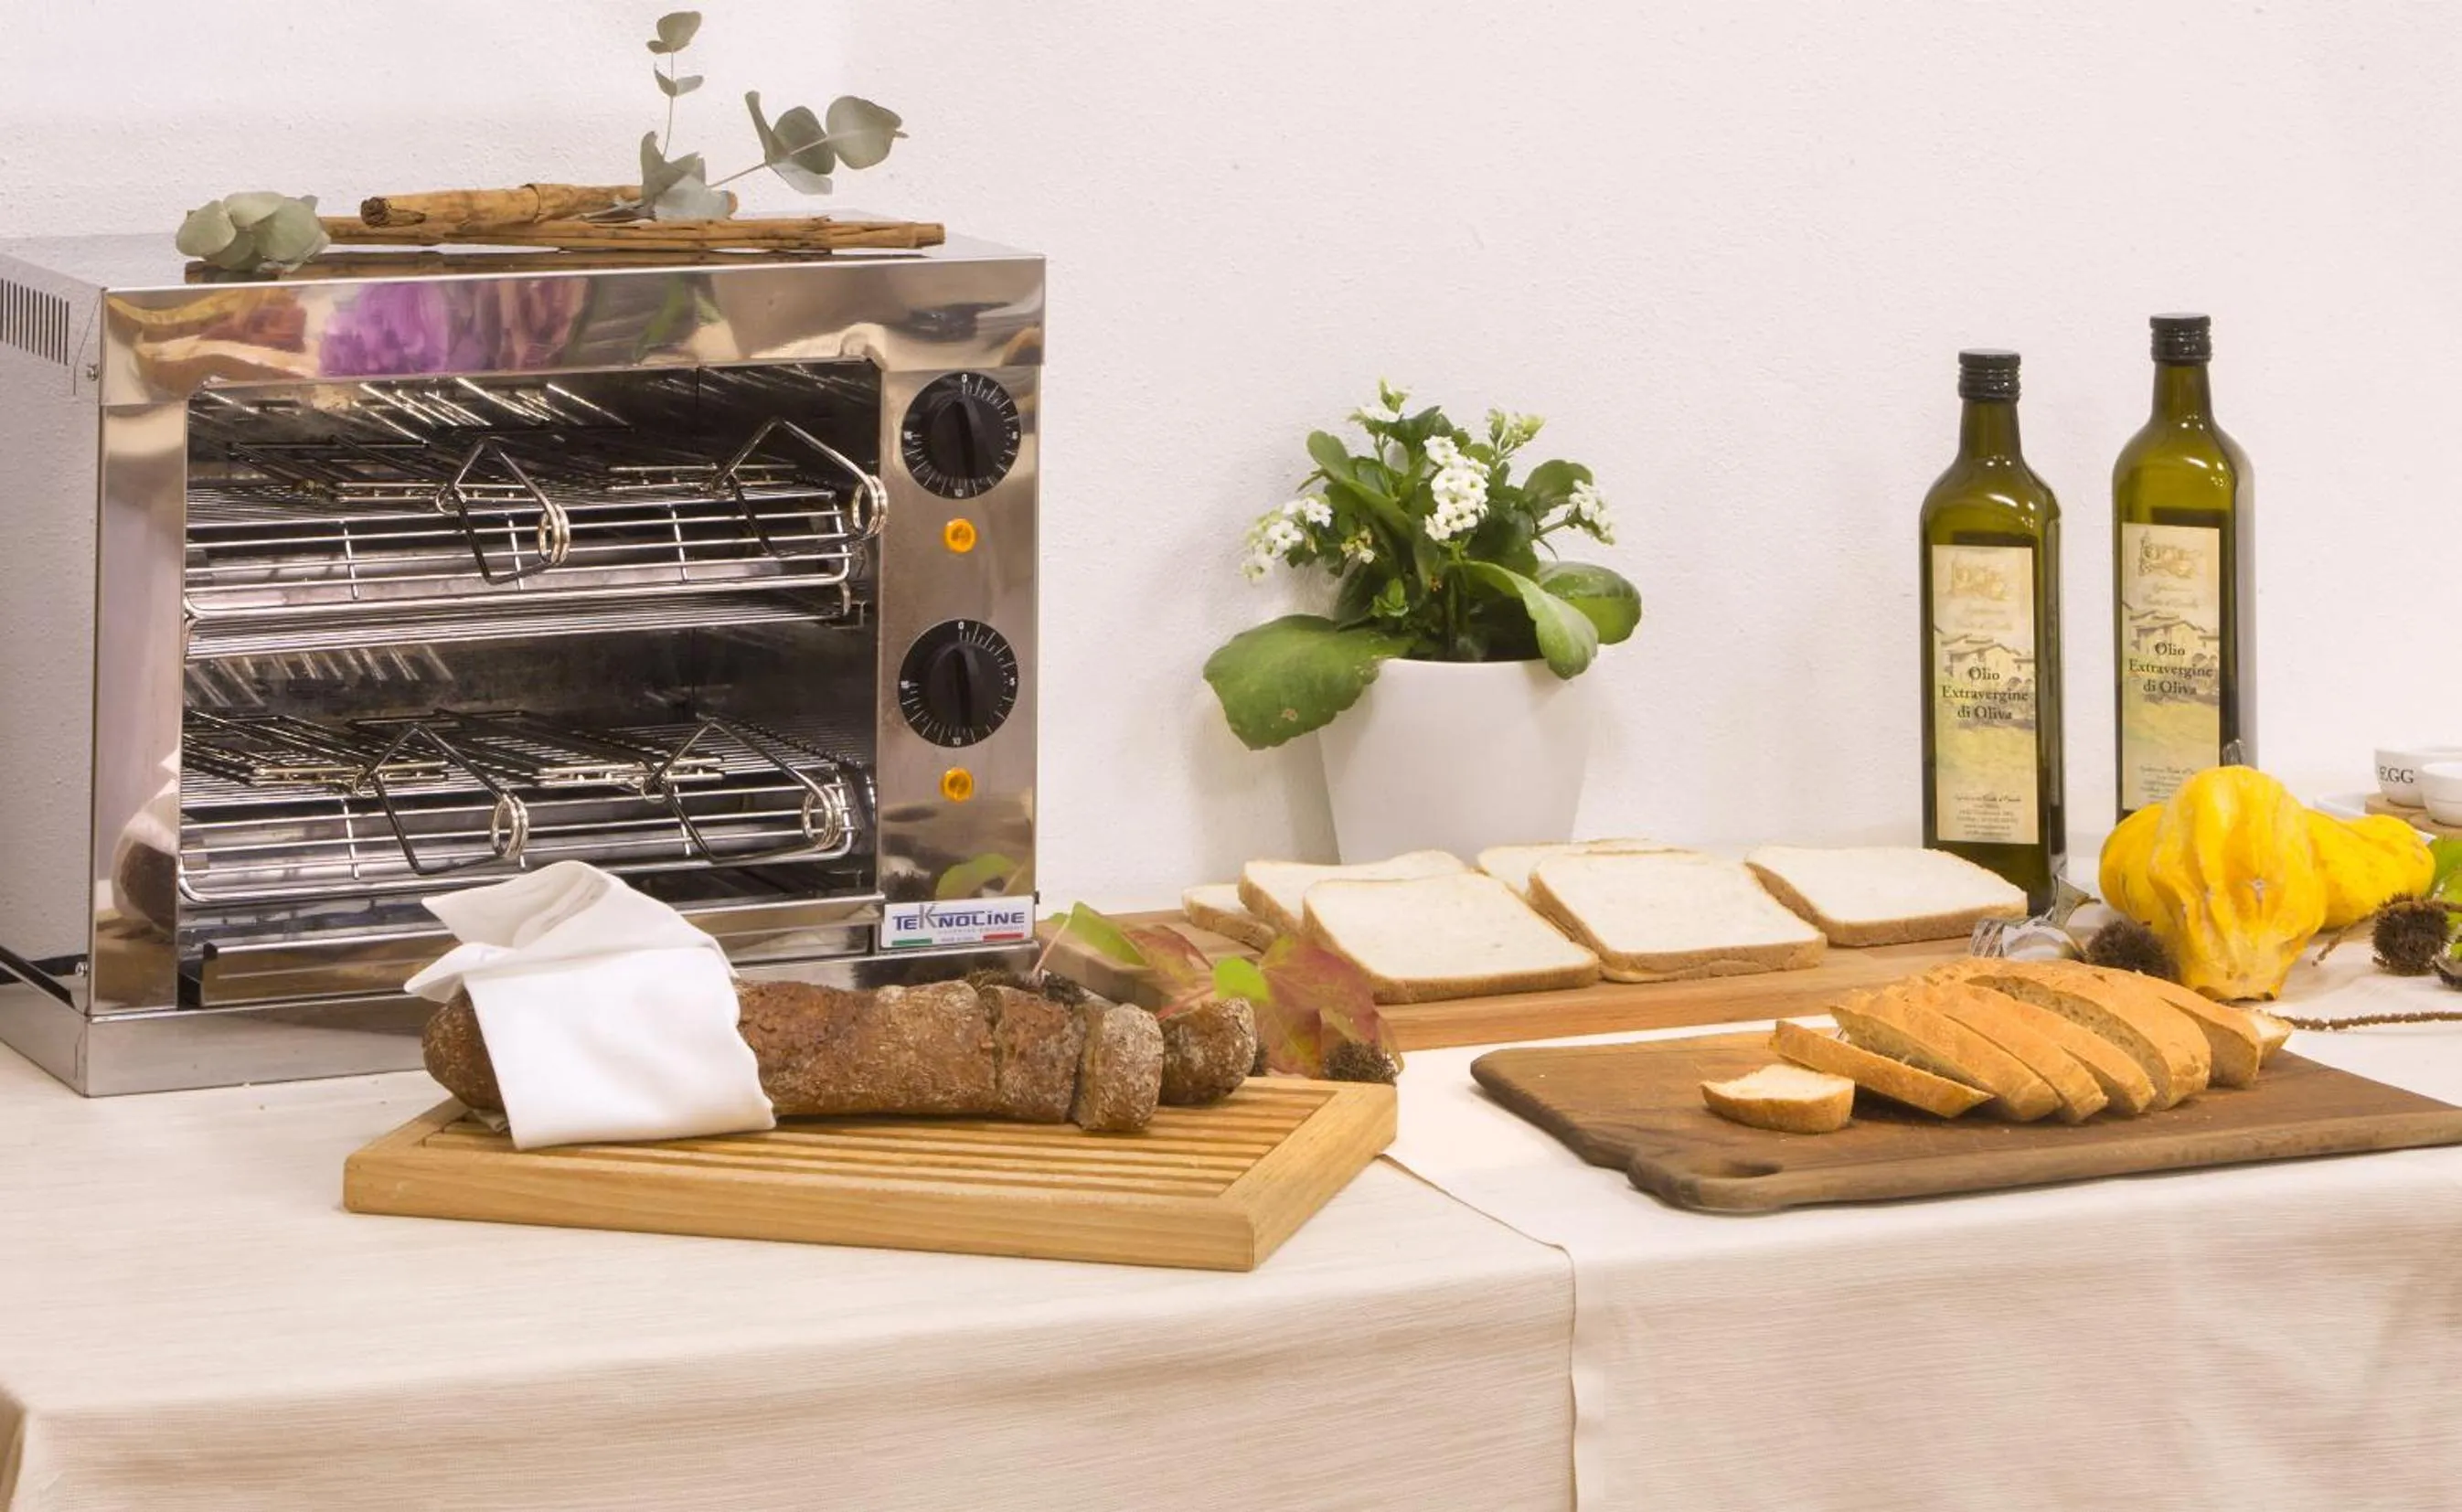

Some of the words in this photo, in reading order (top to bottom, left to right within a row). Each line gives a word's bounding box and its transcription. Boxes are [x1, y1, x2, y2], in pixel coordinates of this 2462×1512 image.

[2155, 643, 2185, 655] Olio
[1968, 666, 2000, 680] Olio
[2129, 658, 2212, 679] Extravergine
[1943, 686, 2028, 704] Extravergine
[2143, 679, 2156, 692] di
[2158, 681, 2197, 695] Oliva
[1957, 704, 1970, 719] di
[1975, 706, 2012, 719] Oliva
[2379, 766, 2414, 783] EGG
